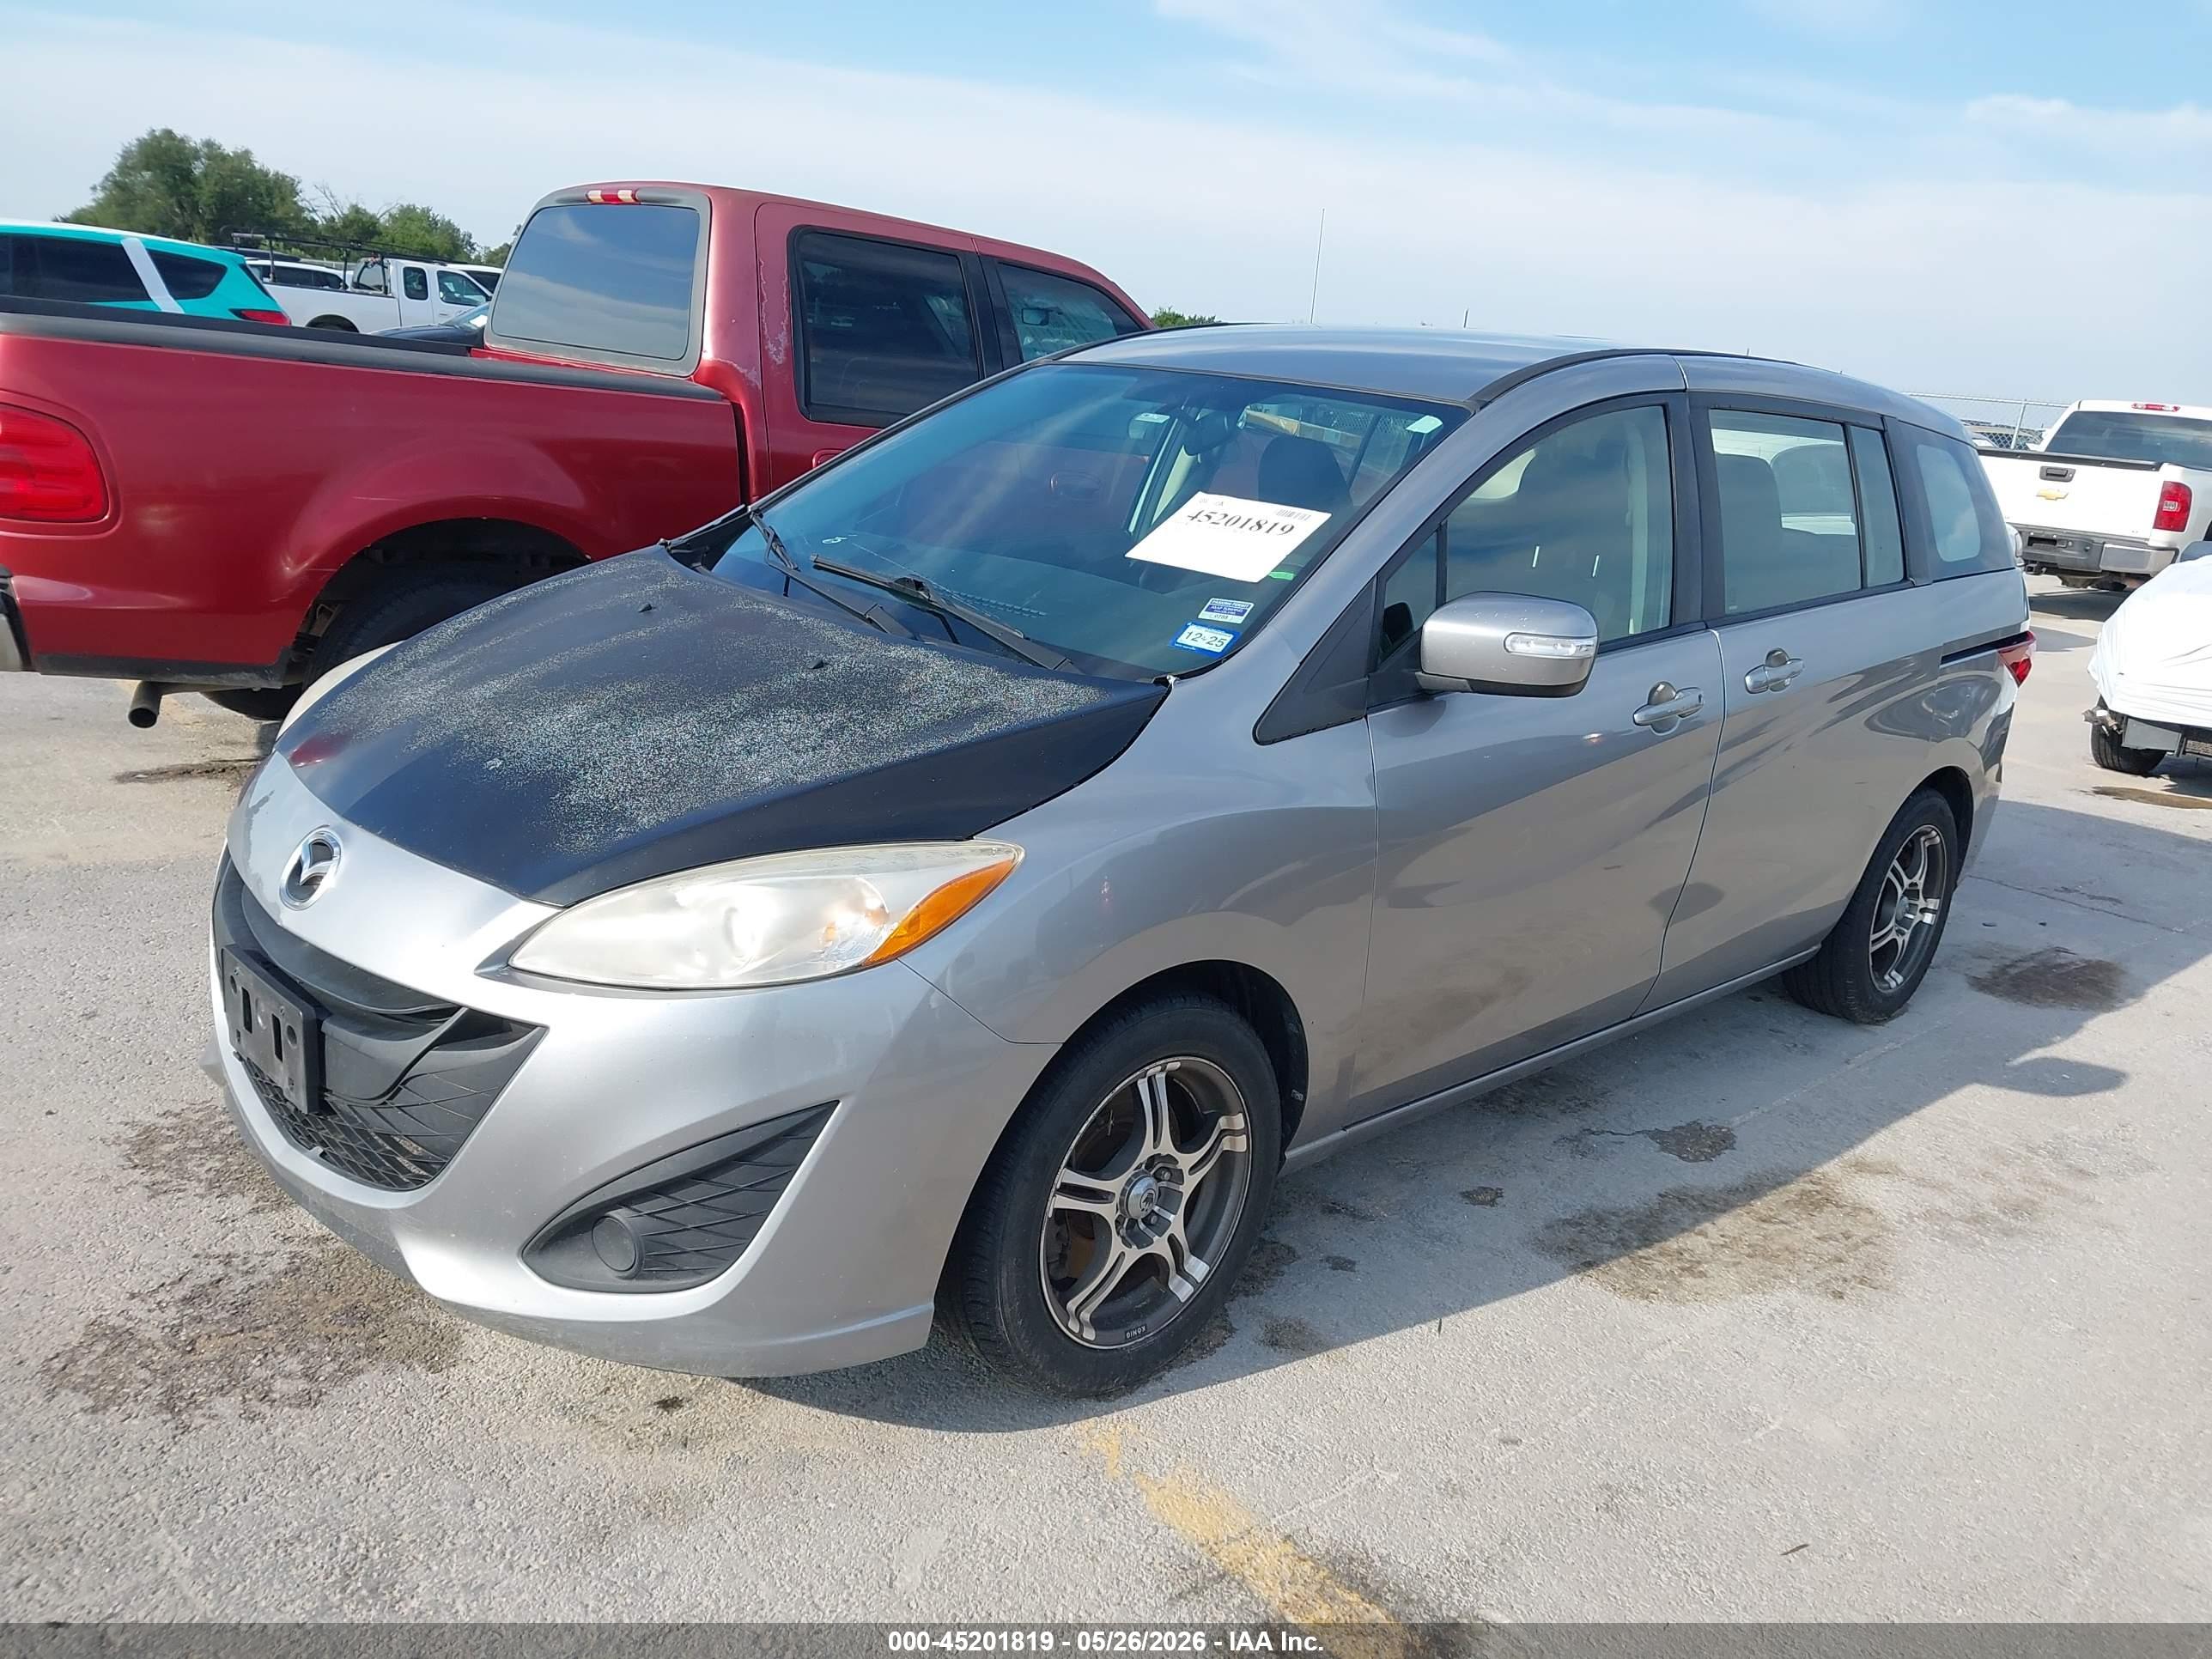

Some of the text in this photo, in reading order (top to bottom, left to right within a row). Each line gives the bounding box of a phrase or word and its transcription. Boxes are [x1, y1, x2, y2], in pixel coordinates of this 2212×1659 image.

[1187, 509, 1295, 536] 45201819
[1185, 630, 1203, 642] 12
[1206, 635, 1228, 647] 25
